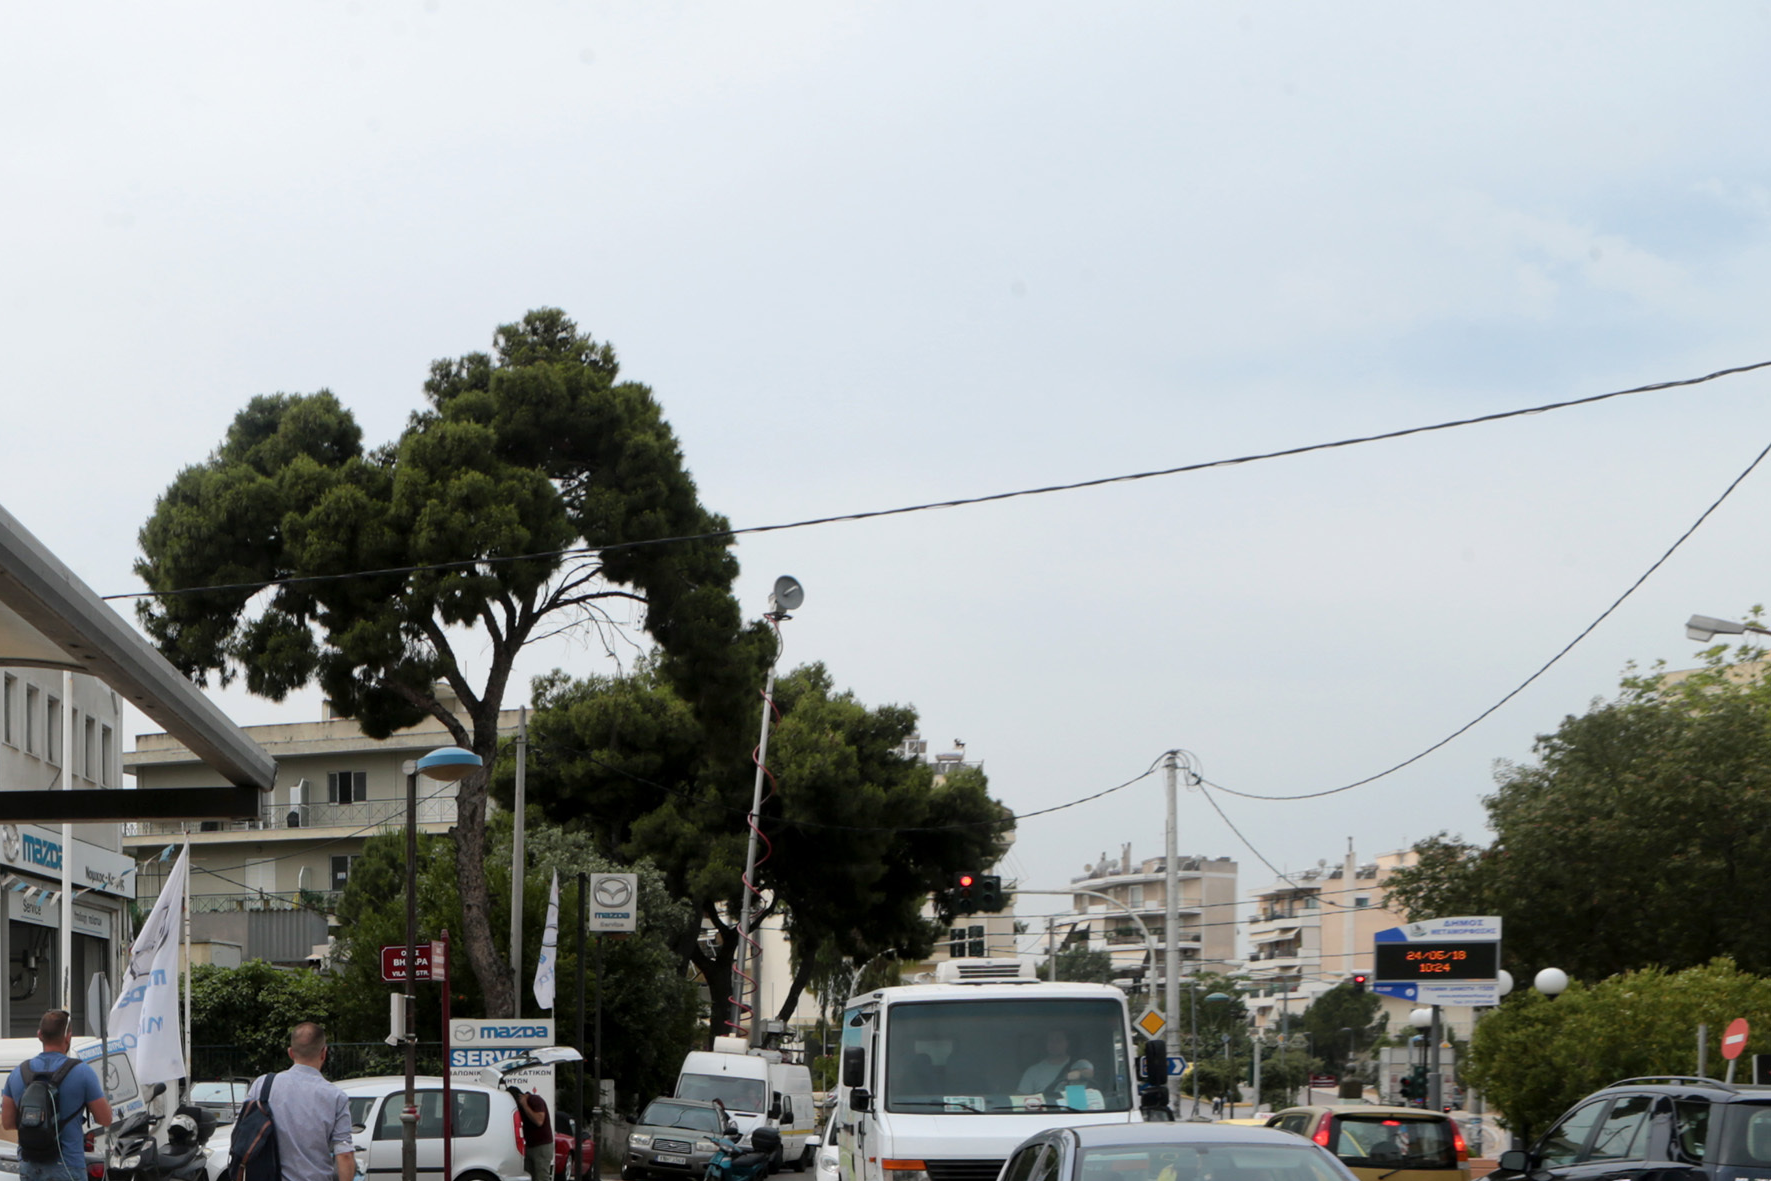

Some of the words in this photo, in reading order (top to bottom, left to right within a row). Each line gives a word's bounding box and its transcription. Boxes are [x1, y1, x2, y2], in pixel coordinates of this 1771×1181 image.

[23, 898, 42, 916] Service
[1443, 919, 1485, 927] ΔΗΜΟΣ
[480, 1026, 549, 1039] mazda
